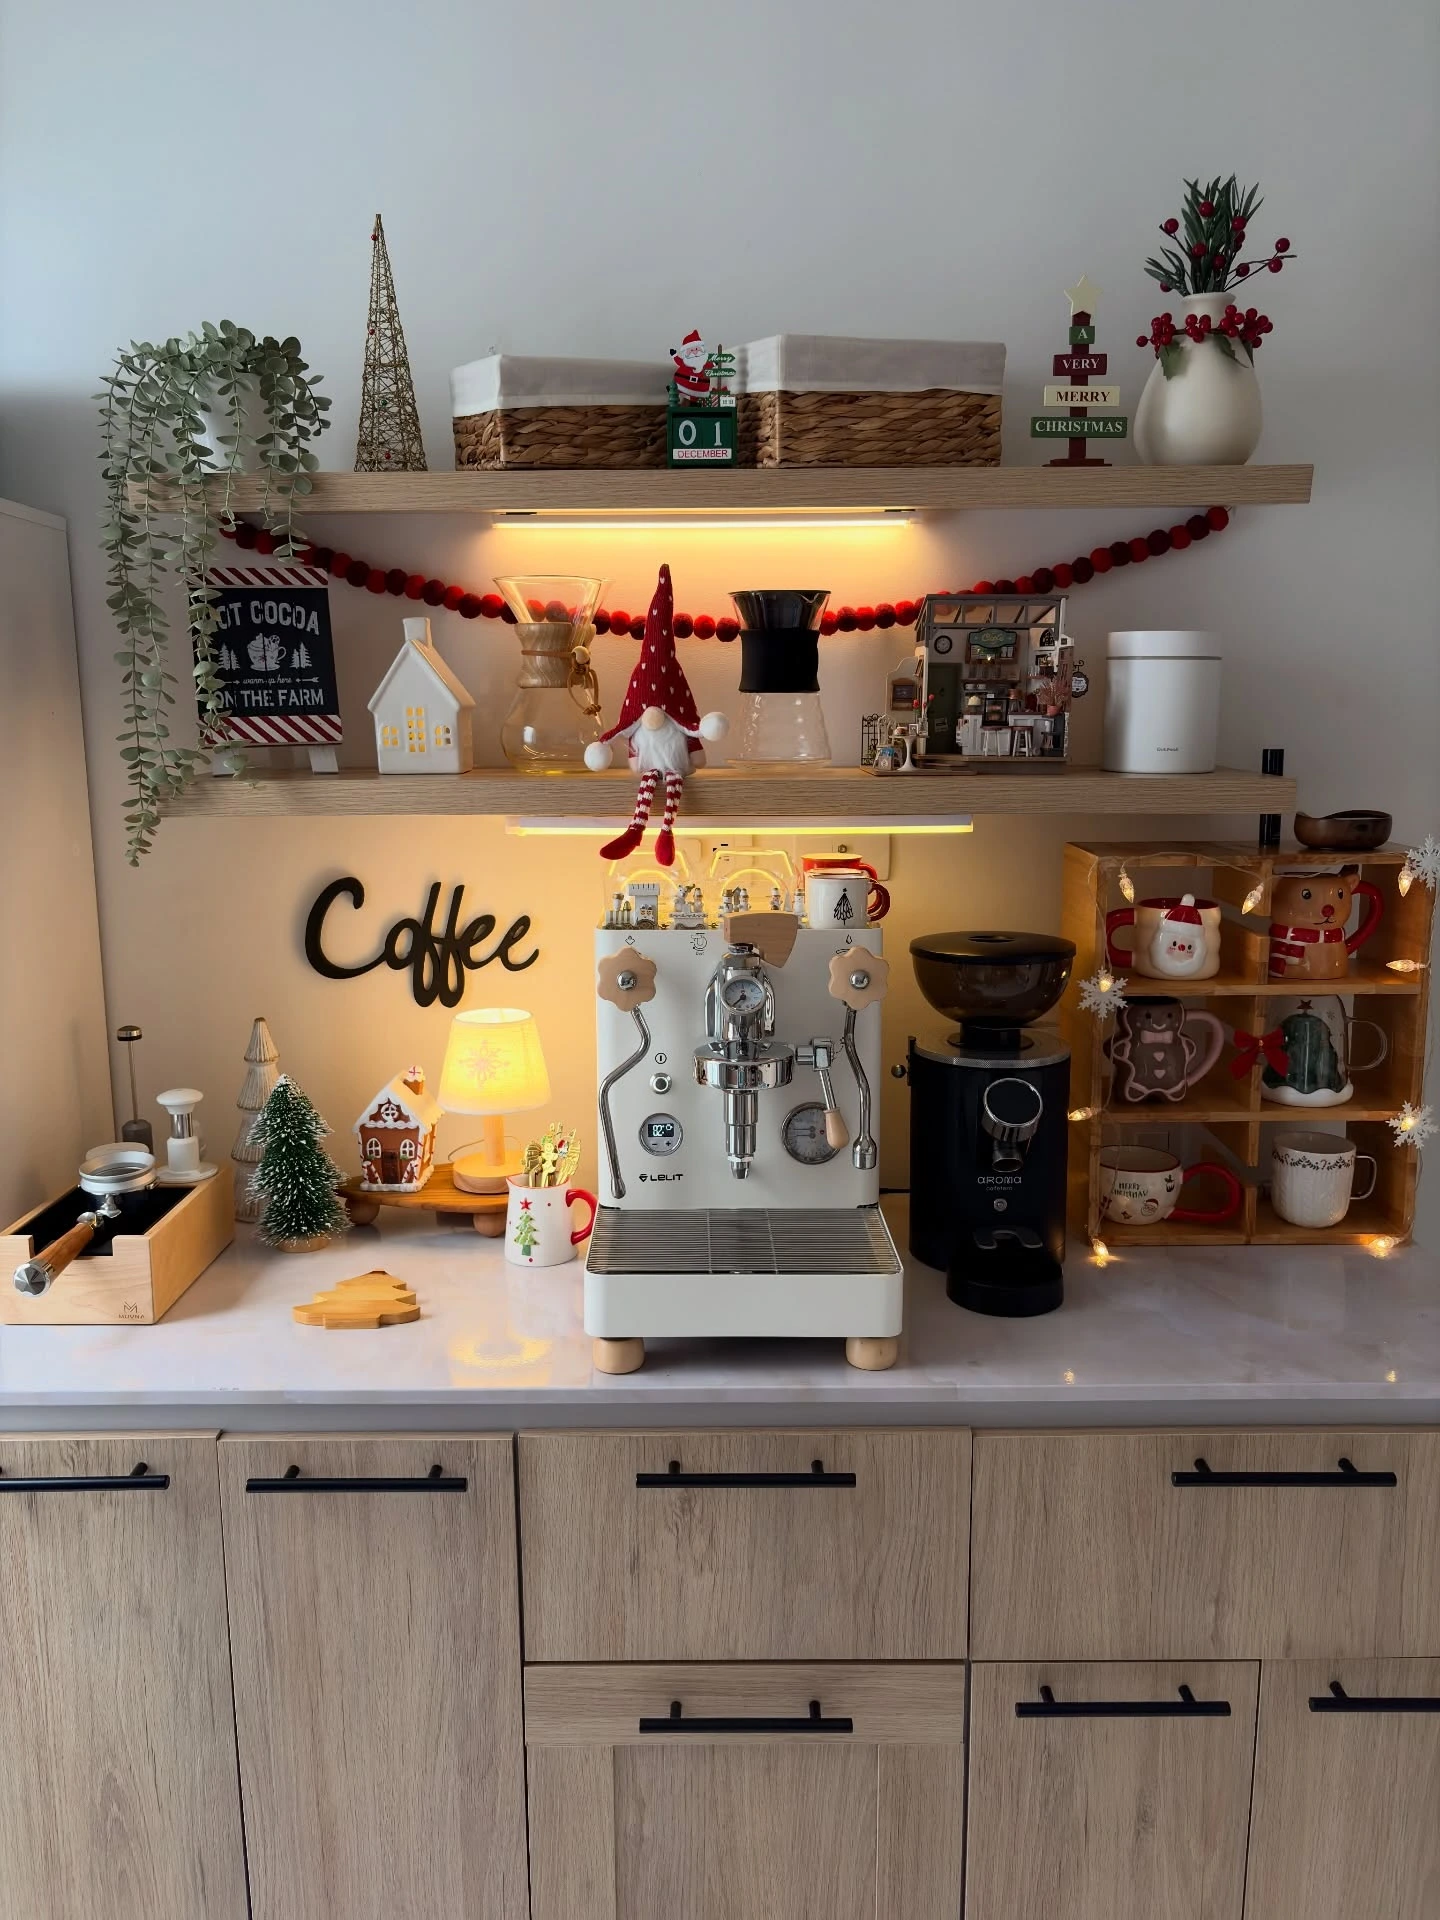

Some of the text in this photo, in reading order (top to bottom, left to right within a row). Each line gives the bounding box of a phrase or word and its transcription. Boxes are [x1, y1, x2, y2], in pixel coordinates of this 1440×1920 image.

[1077, 328, 1089, 340] A
[1062, 357, 1100, 370] VERY
[1056, 390, 1111, 402] MERRY
[1035, 419, 1123, 433] CHRISTMAS
[677, 449, 728, 459] DECEMBER
[216, 600, 320, 636] OT COCOA
[240, 689, 275, 708] THE
[277, 688, 324, 707] FARM
[304, 876, 540, 1009] Coffee
